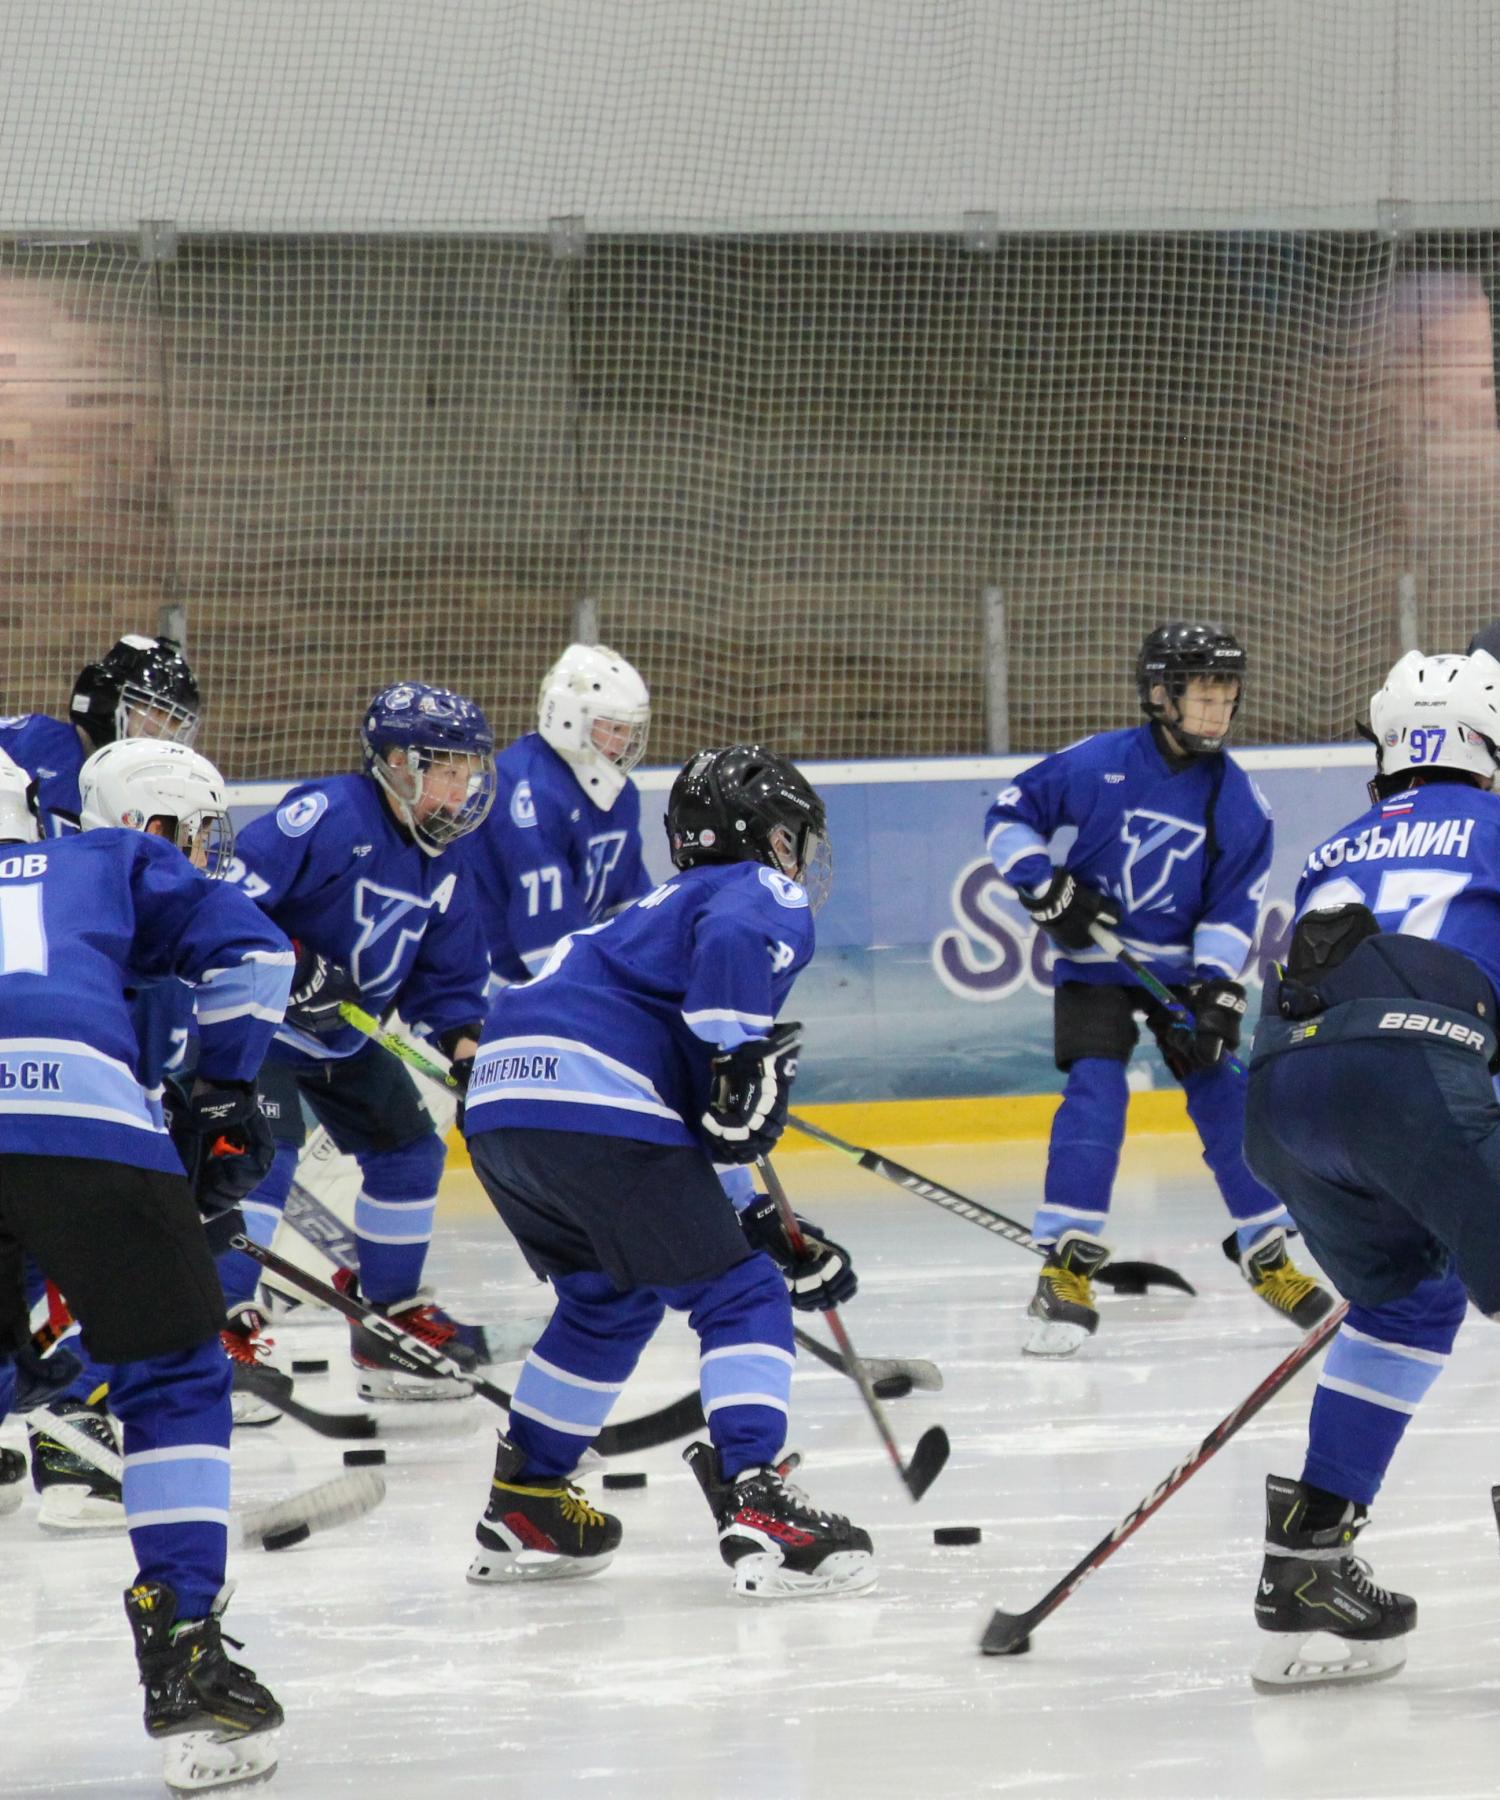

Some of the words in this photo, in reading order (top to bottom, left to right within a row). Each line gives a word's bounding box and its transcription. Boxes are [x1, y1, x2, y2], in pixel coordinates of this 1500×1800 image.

[1409, 728, 1447, 764] 97
[780, 789, 811, 810] BAUER
[431, 874, 457, 914] A
[520, 865, 563, 917] 77
[1378, 1011, 1486, 1051] BAUER
